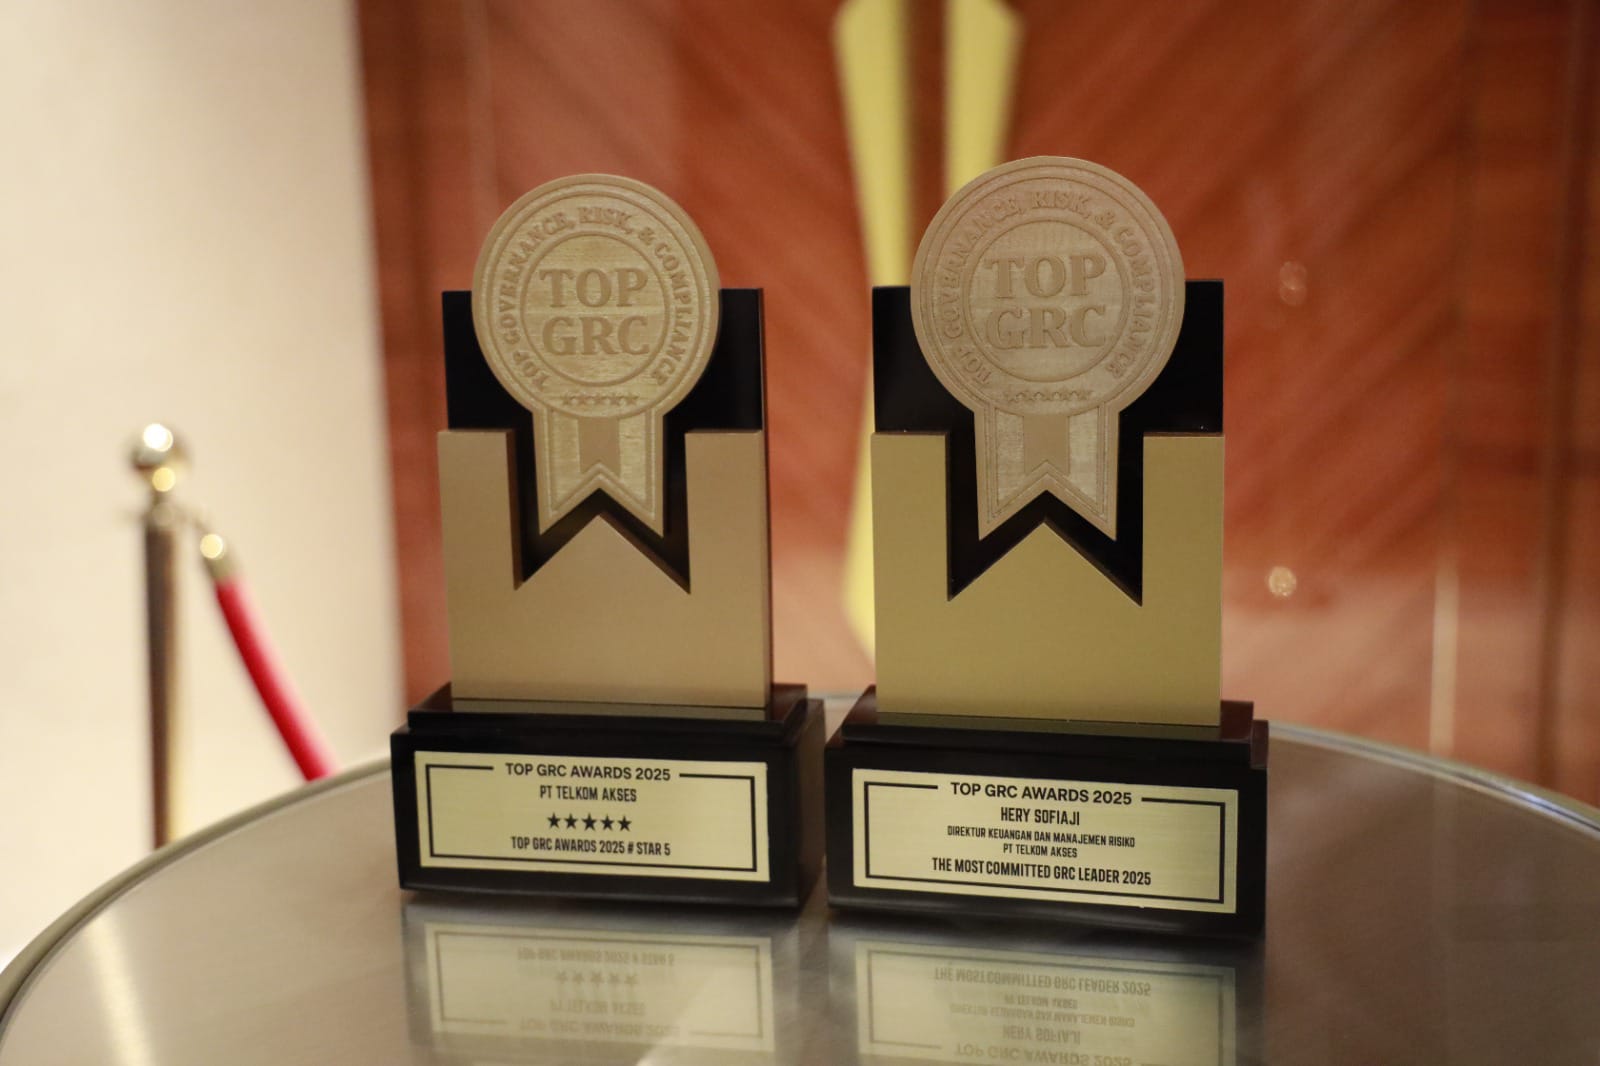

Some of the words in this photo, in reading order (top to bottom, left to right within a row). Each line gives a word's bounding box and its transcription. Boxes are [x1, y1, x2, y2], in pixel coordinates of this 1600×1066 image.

[540, 267, 648, 308] TOP
[983, 254, 1106, 299] TOP
[513, 352, 551, 391] TOP
[637, 227, 655, 246] &
[652, 242, 693, 386] COMPLIANCE
[1105, 225, 1155, 378] COMPLIANCE
[542, 315, 649, 355] GRC
[986, 304, 1106, 349] GRC
[505, 762, 533, 776] TOP
[537, 764, 566, 777] GRC
[570, 765, 632, 780] AWARDS
[635, 768, 671, 781] 2025
[540, 785, 551, 799] PT
[556, 785, 598, 801] TELKOM
[602, 787, 637, 802] AKSES
[951, 782, 981, 796] TOP
[985, 784, 1018, 799] GRC
[1021, 786, 1089, 803] AWARDS
[1093, 790, 1132, 805] 2025
[1000, 807, 1030, 822] HERY
[1034, 808, 1080, 826] SOFIAJI
[511, 836, 530, 849] TOP
[532, 837, 552, 851] GRC
[555, 838, 597, 853] AWARDS
[599, 840, 625, 854] 2025
[627, 842, 634, 854] #
[636, 842, 662, 856] STAR
[664, 843, 671, 856] 5
[947, 825, 986, 838] DIREKTUR
[988, 828, 1032, 841] KEUANGAN
[1034, 830, 1051, 842] DAN
[1053, 832, 1106, 846] MANAJEMEN
[1108, 836, 1135, 848] RISIKO
[1003, 843, 1012, 854] PT
[1015, 844, 1048, 856] TELKOM
[1050, 847, 1077, 858] AKSES
[932, 857, 952, 872] THE
[954, 859, 985, 874] MOST
[986, 861, 1051, 879] COMMITTED
[1053, 866, 1076, 880] GRC
[1078, 867, 1119, 884] LEADER
[1122, 870, 1151, 886] 2025
